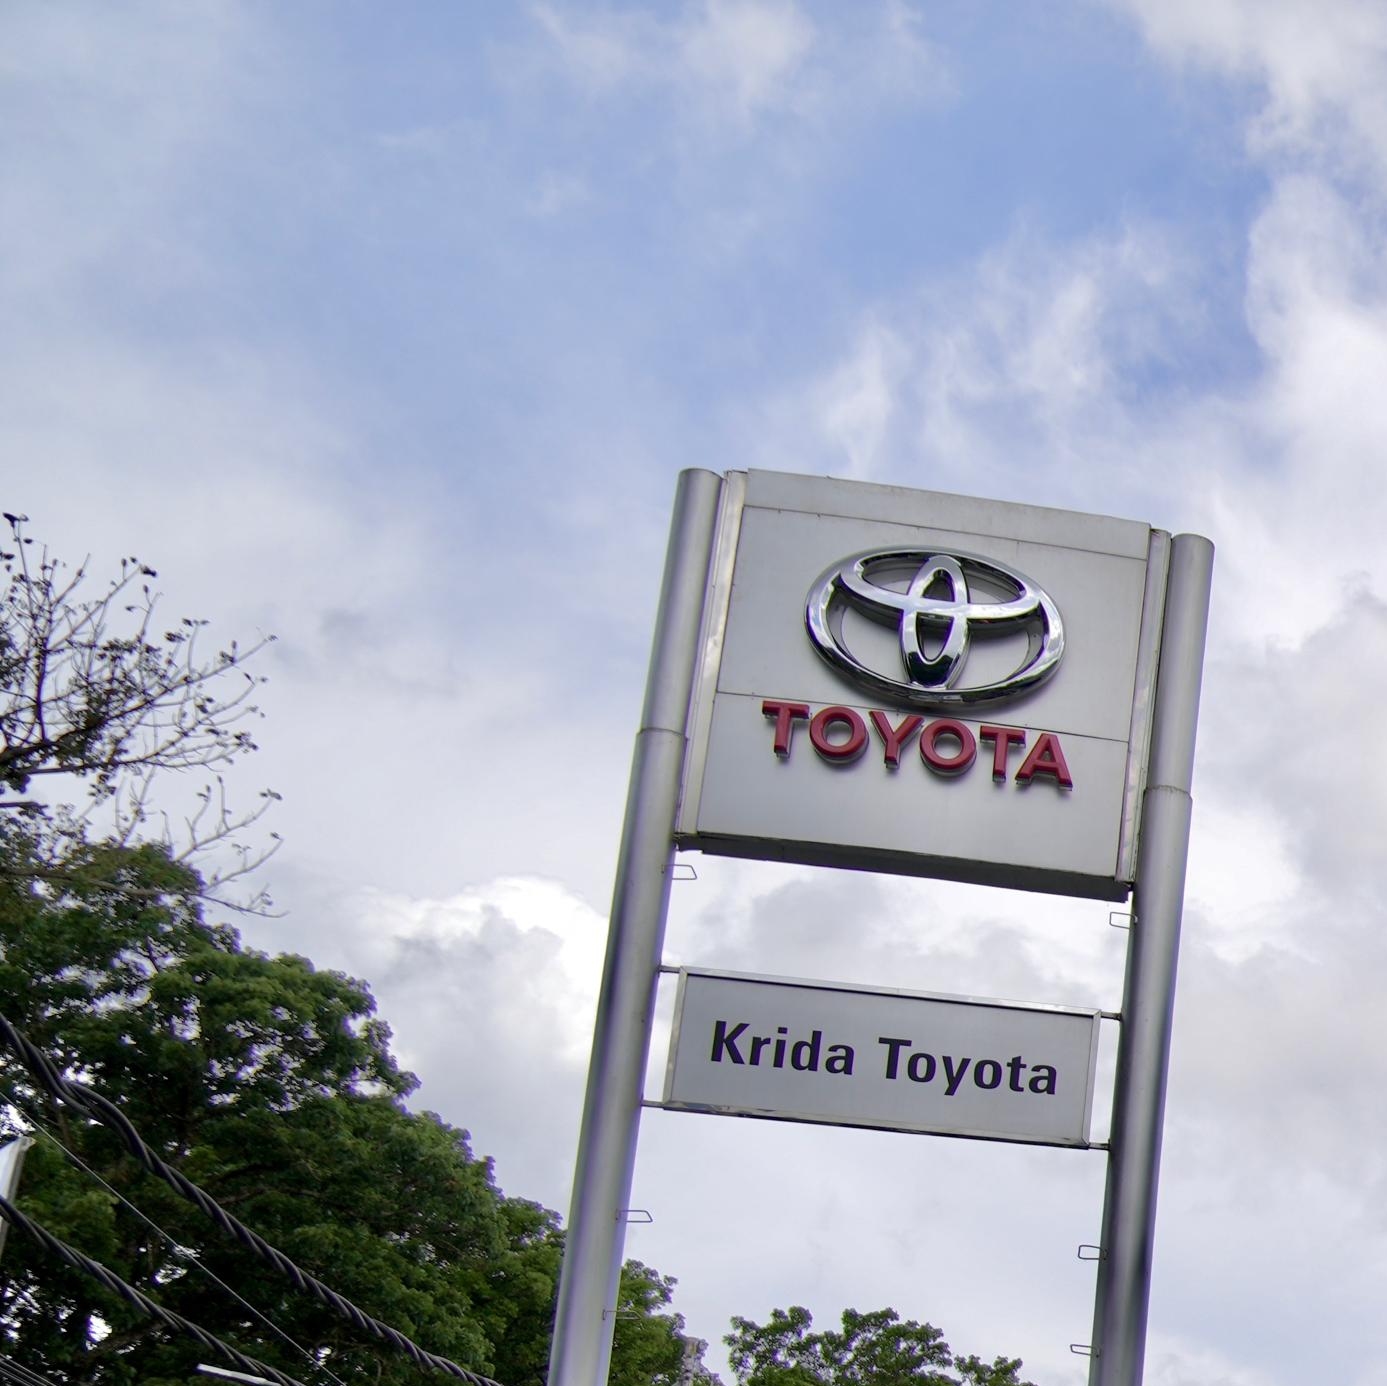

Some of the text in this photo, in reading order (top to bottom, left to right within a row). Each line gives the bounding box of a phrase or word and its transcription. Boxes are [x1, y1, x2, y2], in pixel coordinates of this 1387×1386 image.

[762, 700, 1073, 790] TOYOTA
[711, 1021, 1058, 1096] Krida Toyota
